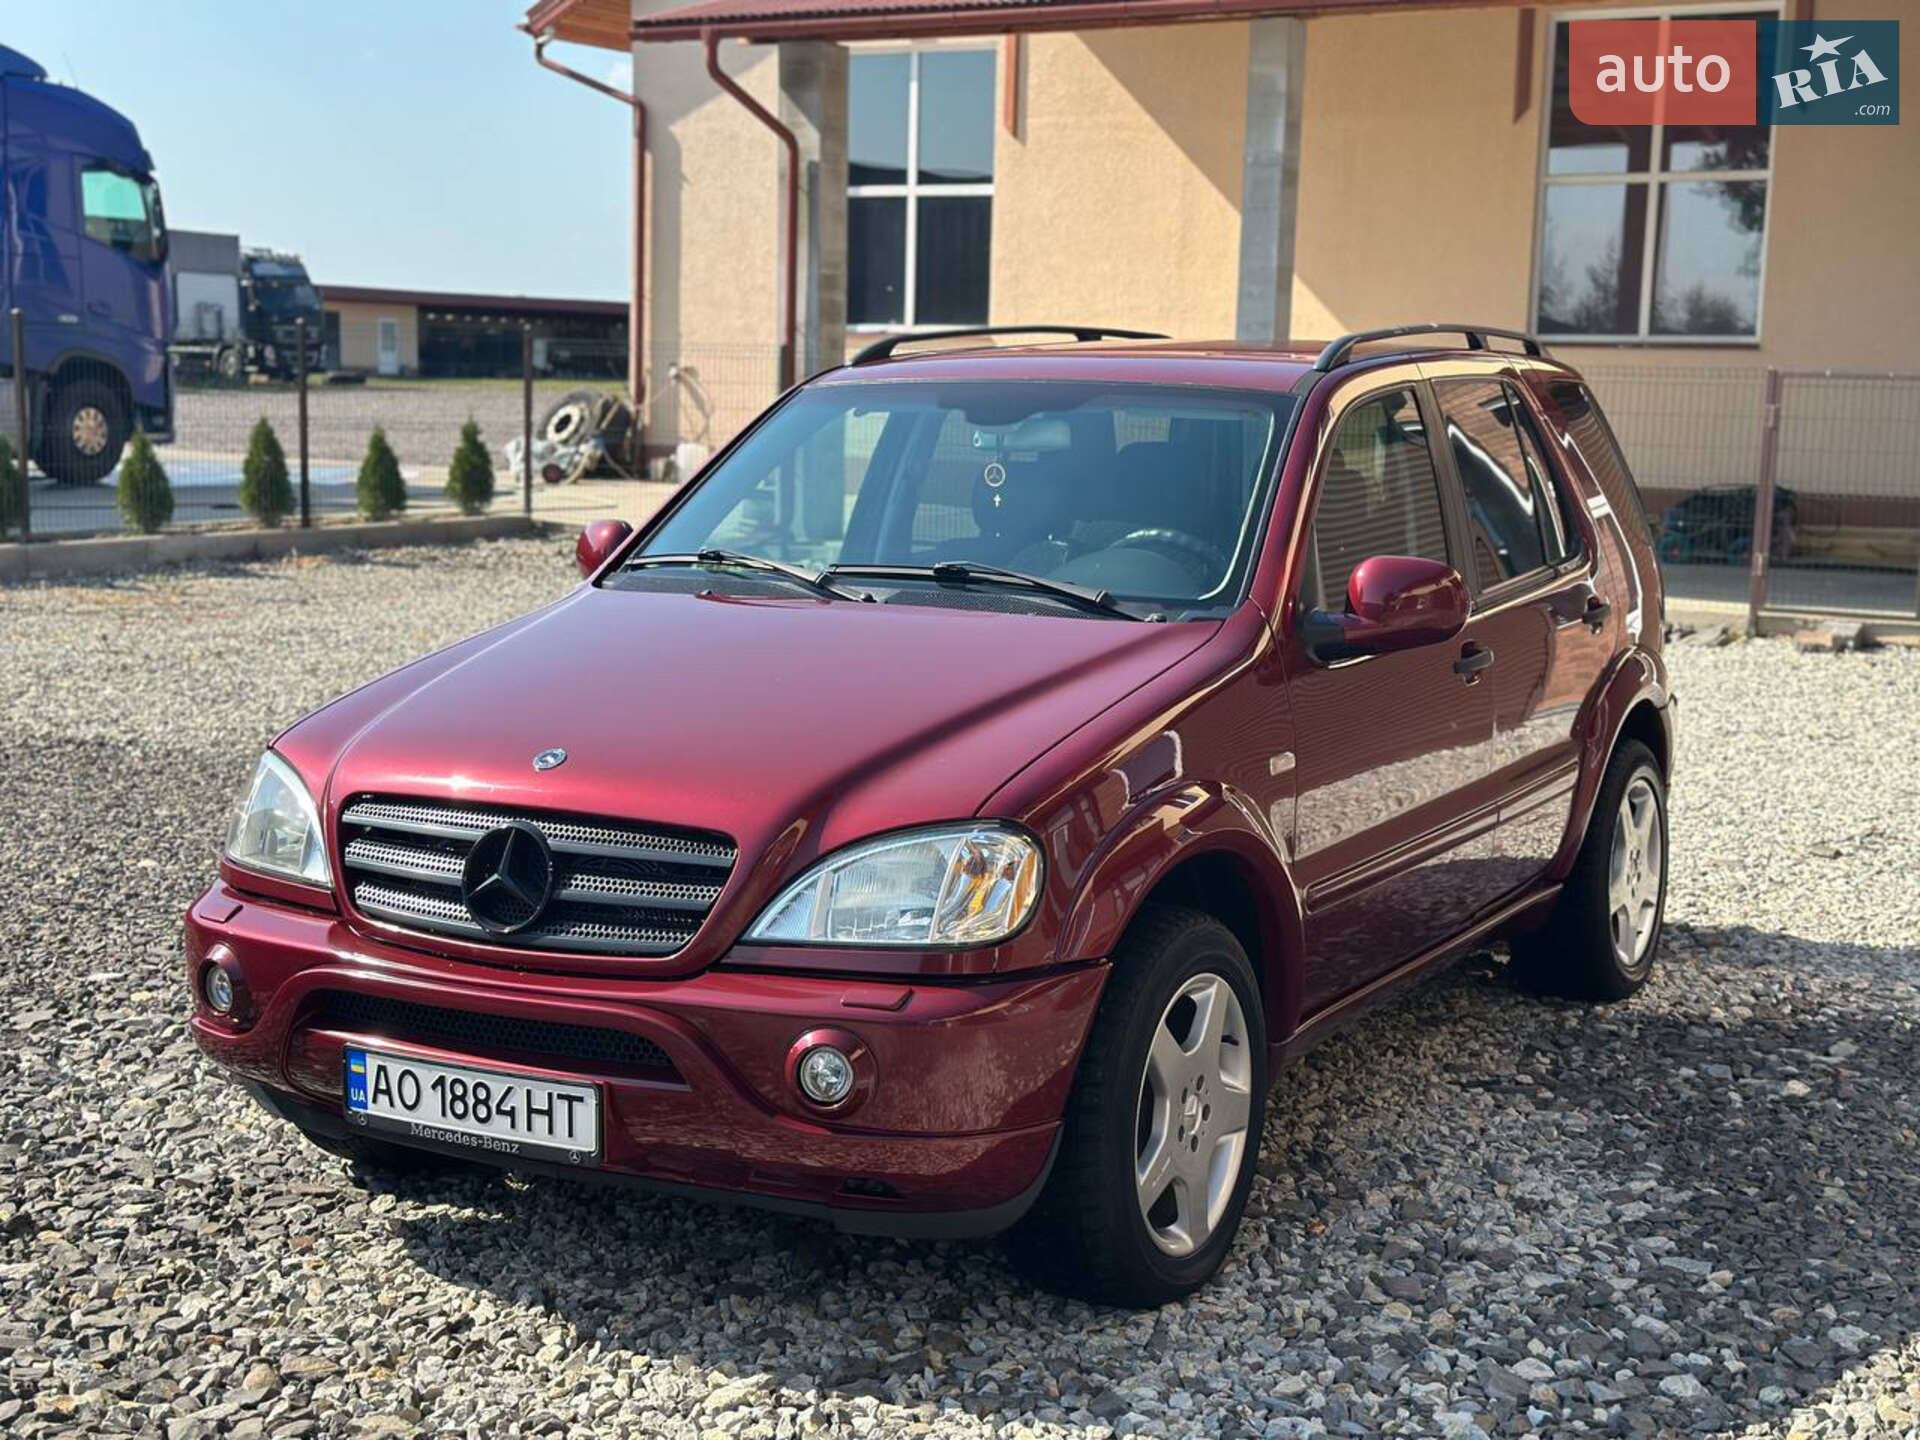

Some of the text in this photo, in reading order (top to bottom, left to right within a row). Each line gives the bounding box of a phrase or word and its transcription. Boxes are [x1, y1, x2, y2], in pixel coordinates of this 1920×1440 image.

[350, 1086, 367, 1103] UA
[371, 1064, 584, 1139] AO 1884 HT
[410, 1122, 520, 1154] Mercedes-Benz
